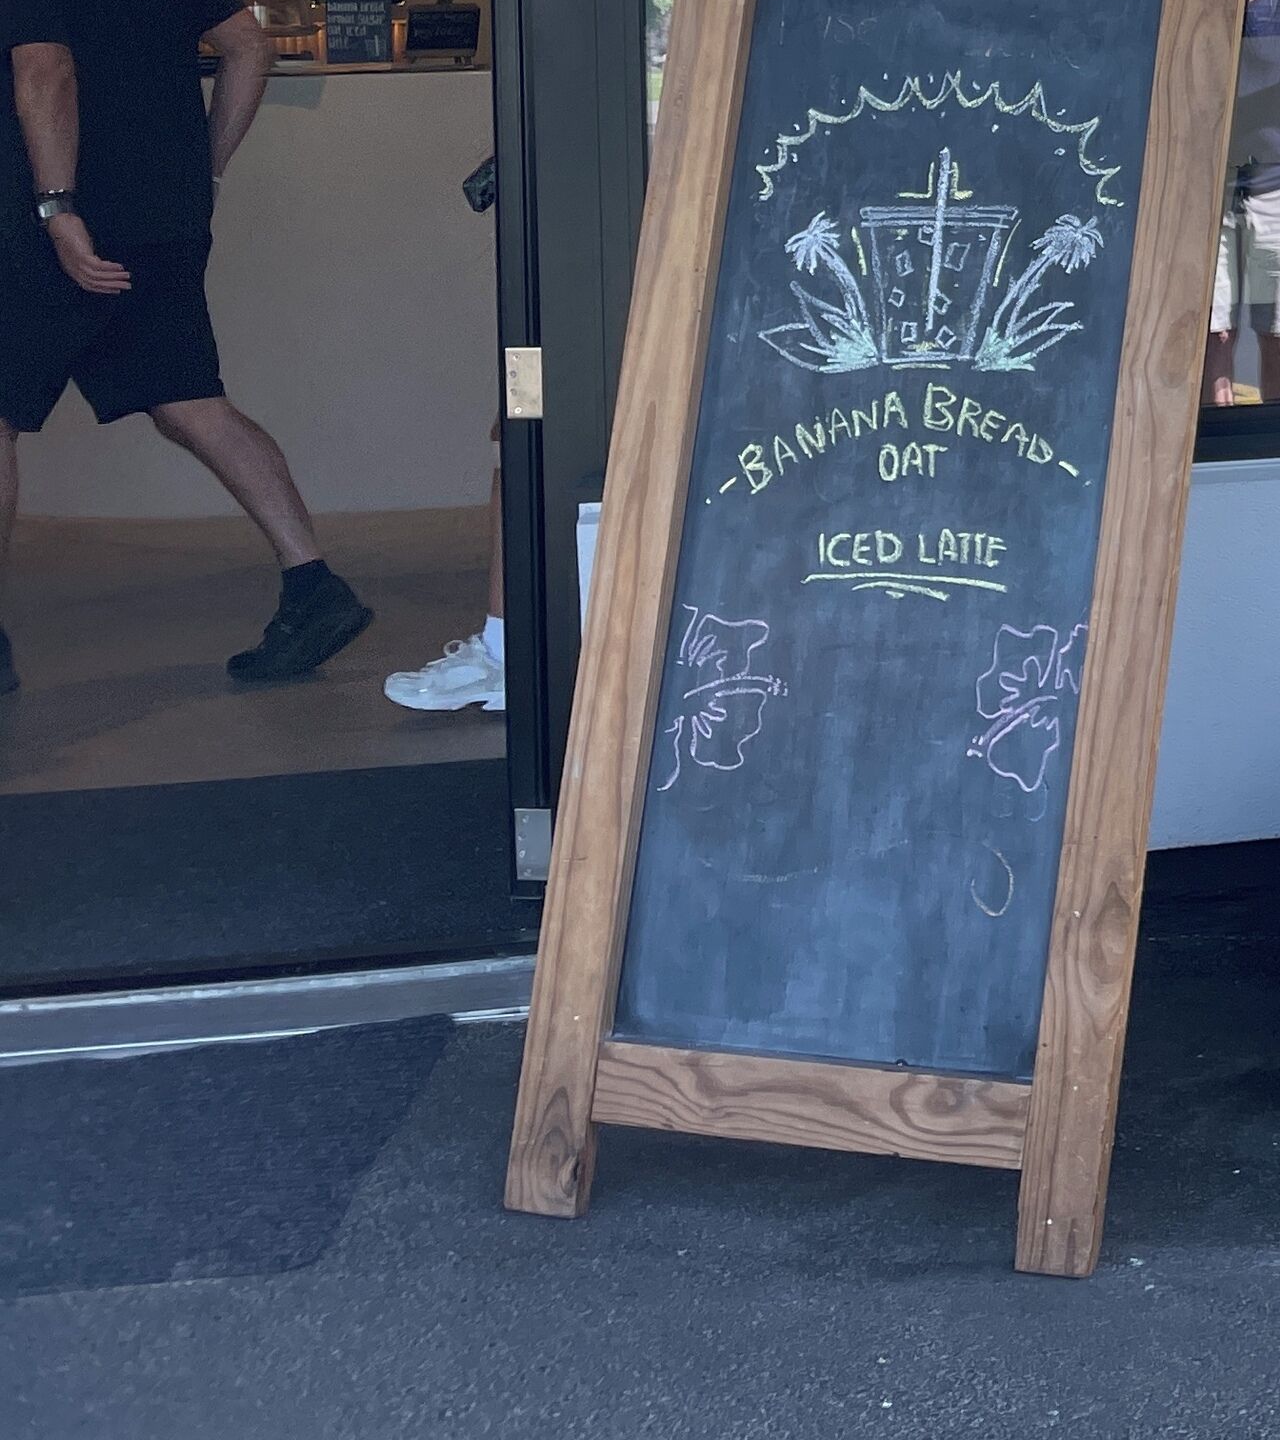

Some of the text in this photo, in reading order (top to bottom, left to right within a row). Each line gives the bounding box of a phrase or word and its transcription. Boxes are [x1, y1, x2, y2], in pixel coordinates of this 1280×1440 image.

[878, 442, 949, 482] OAT
[817, 528, 1008, 569] ICED LATTE
